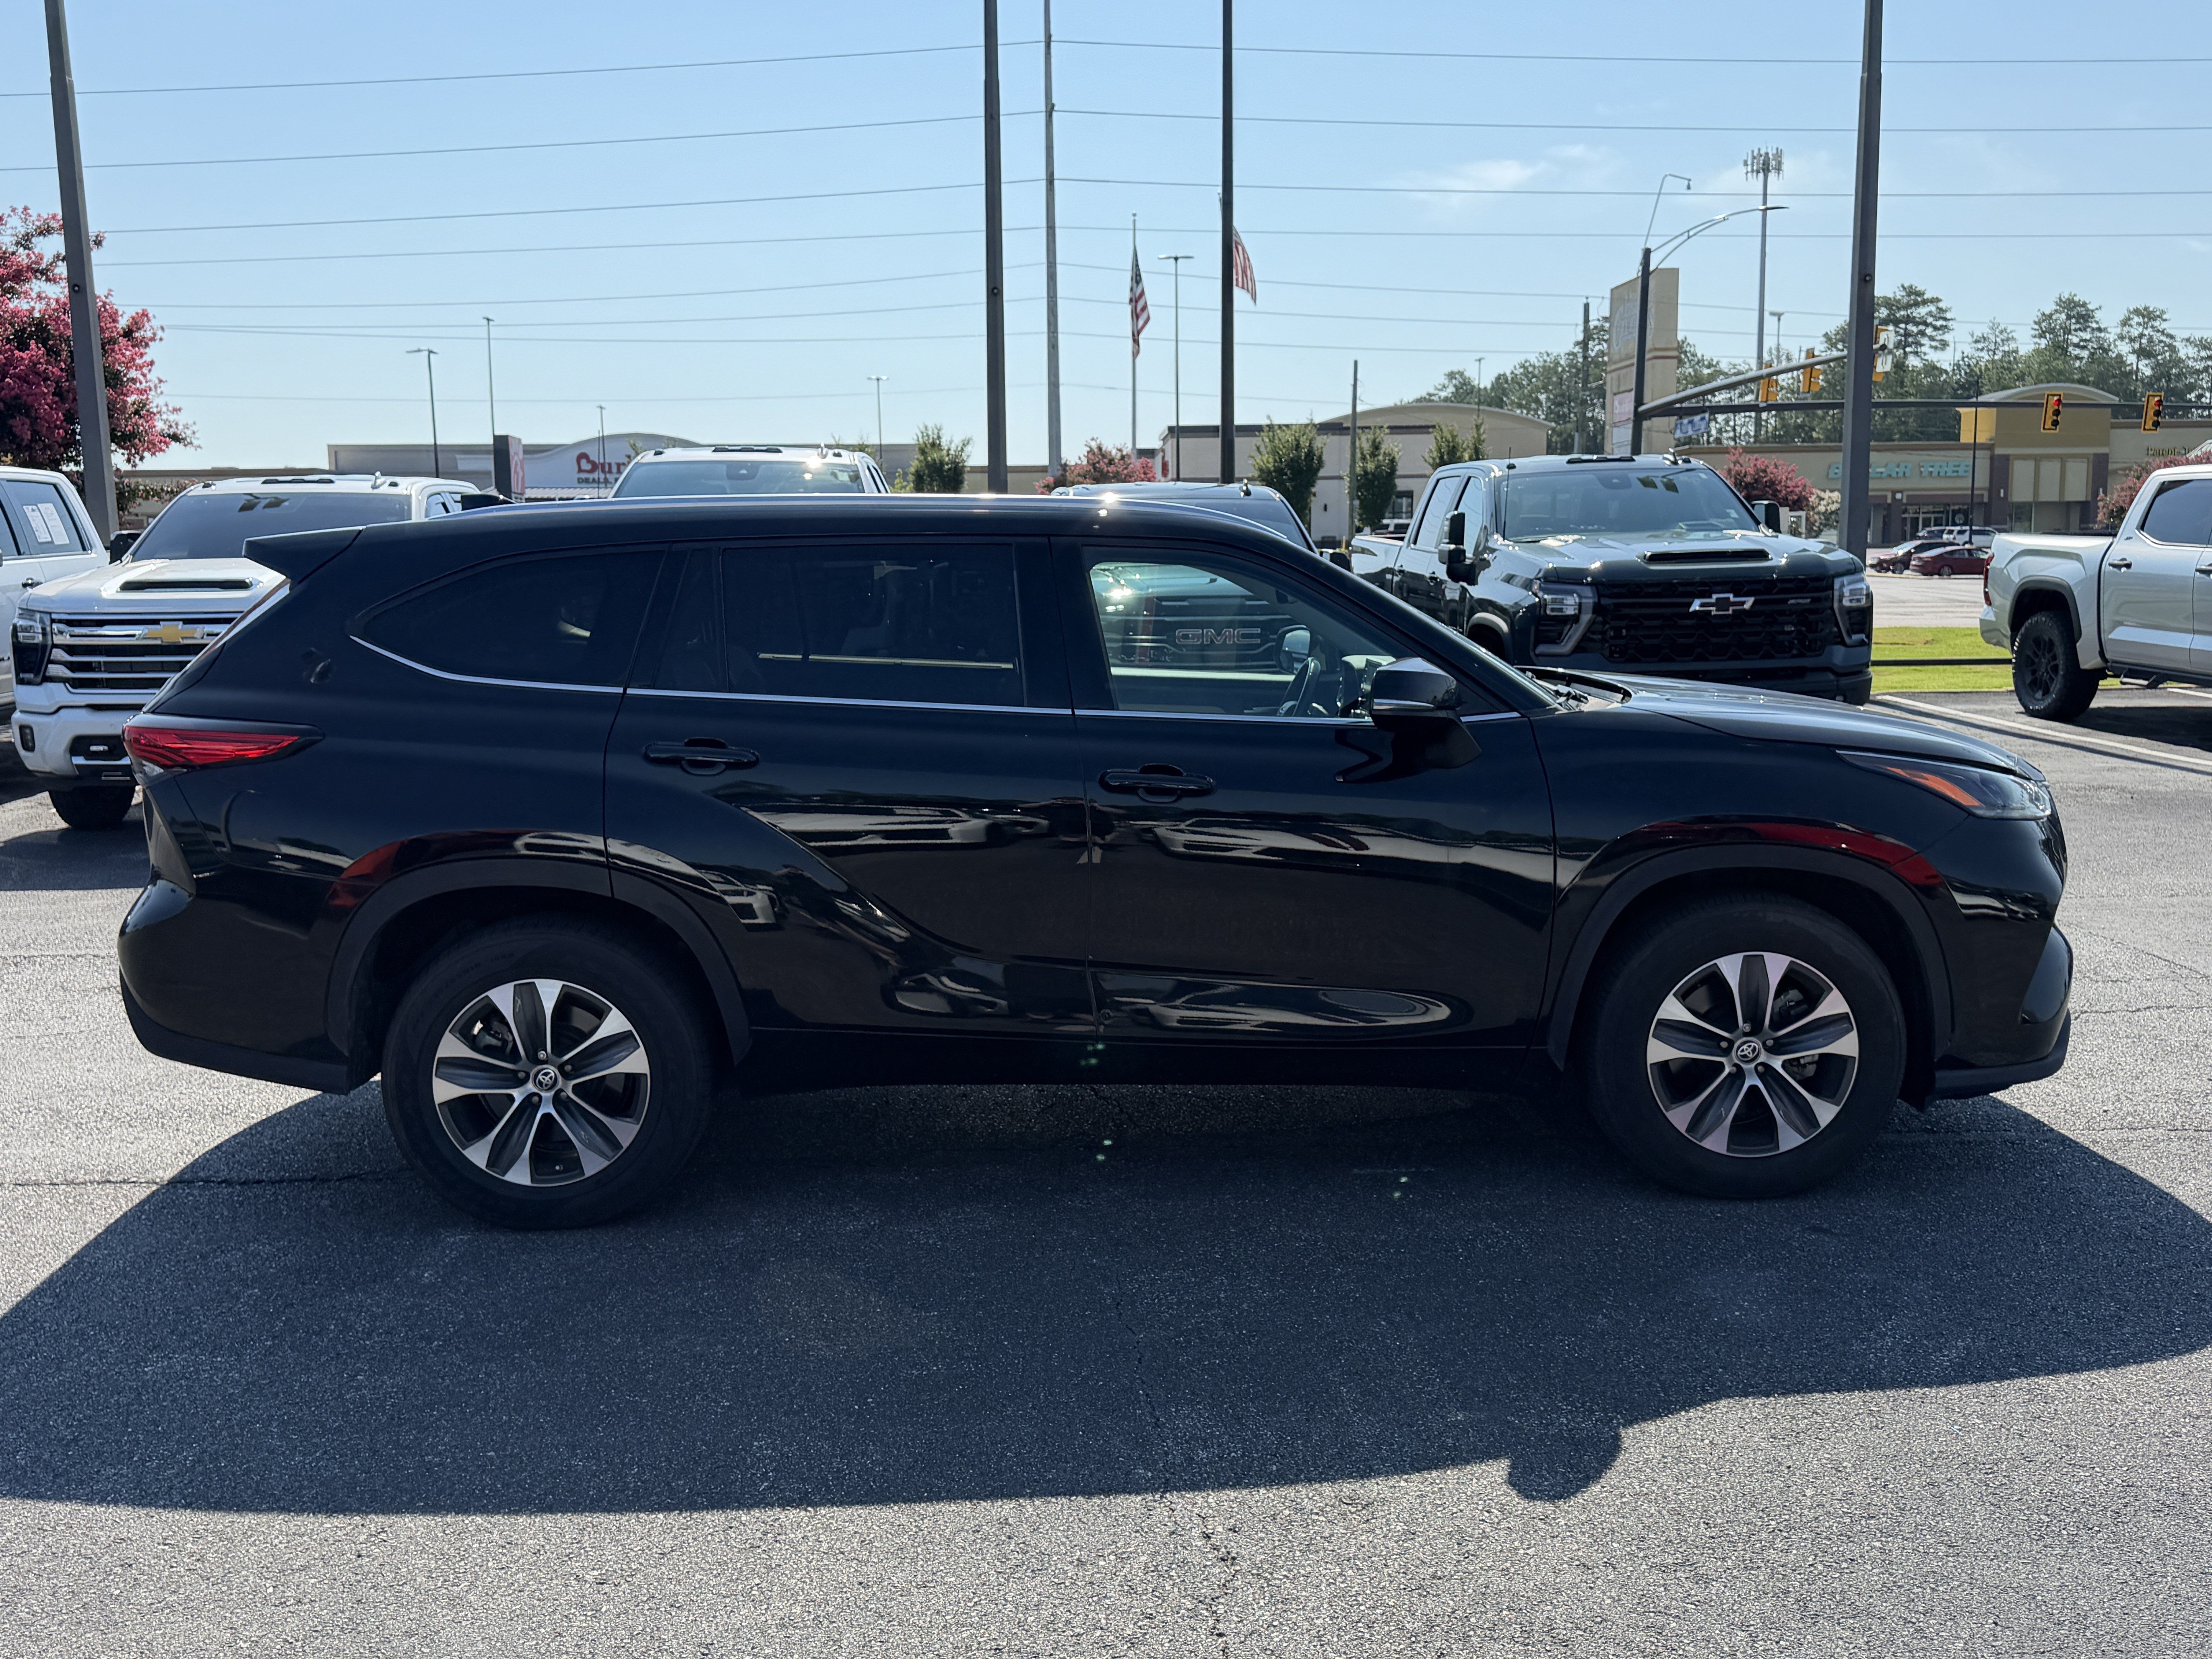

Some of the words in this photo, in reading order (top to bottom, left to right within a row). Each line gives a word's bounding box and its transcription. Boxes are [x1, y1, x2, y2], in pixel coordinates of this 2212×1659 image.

[1828, 462, 1912, 479] DLAR
[1920, 460, 1970, 477] TREE
[1175, 628, 1261, 644] GMC
